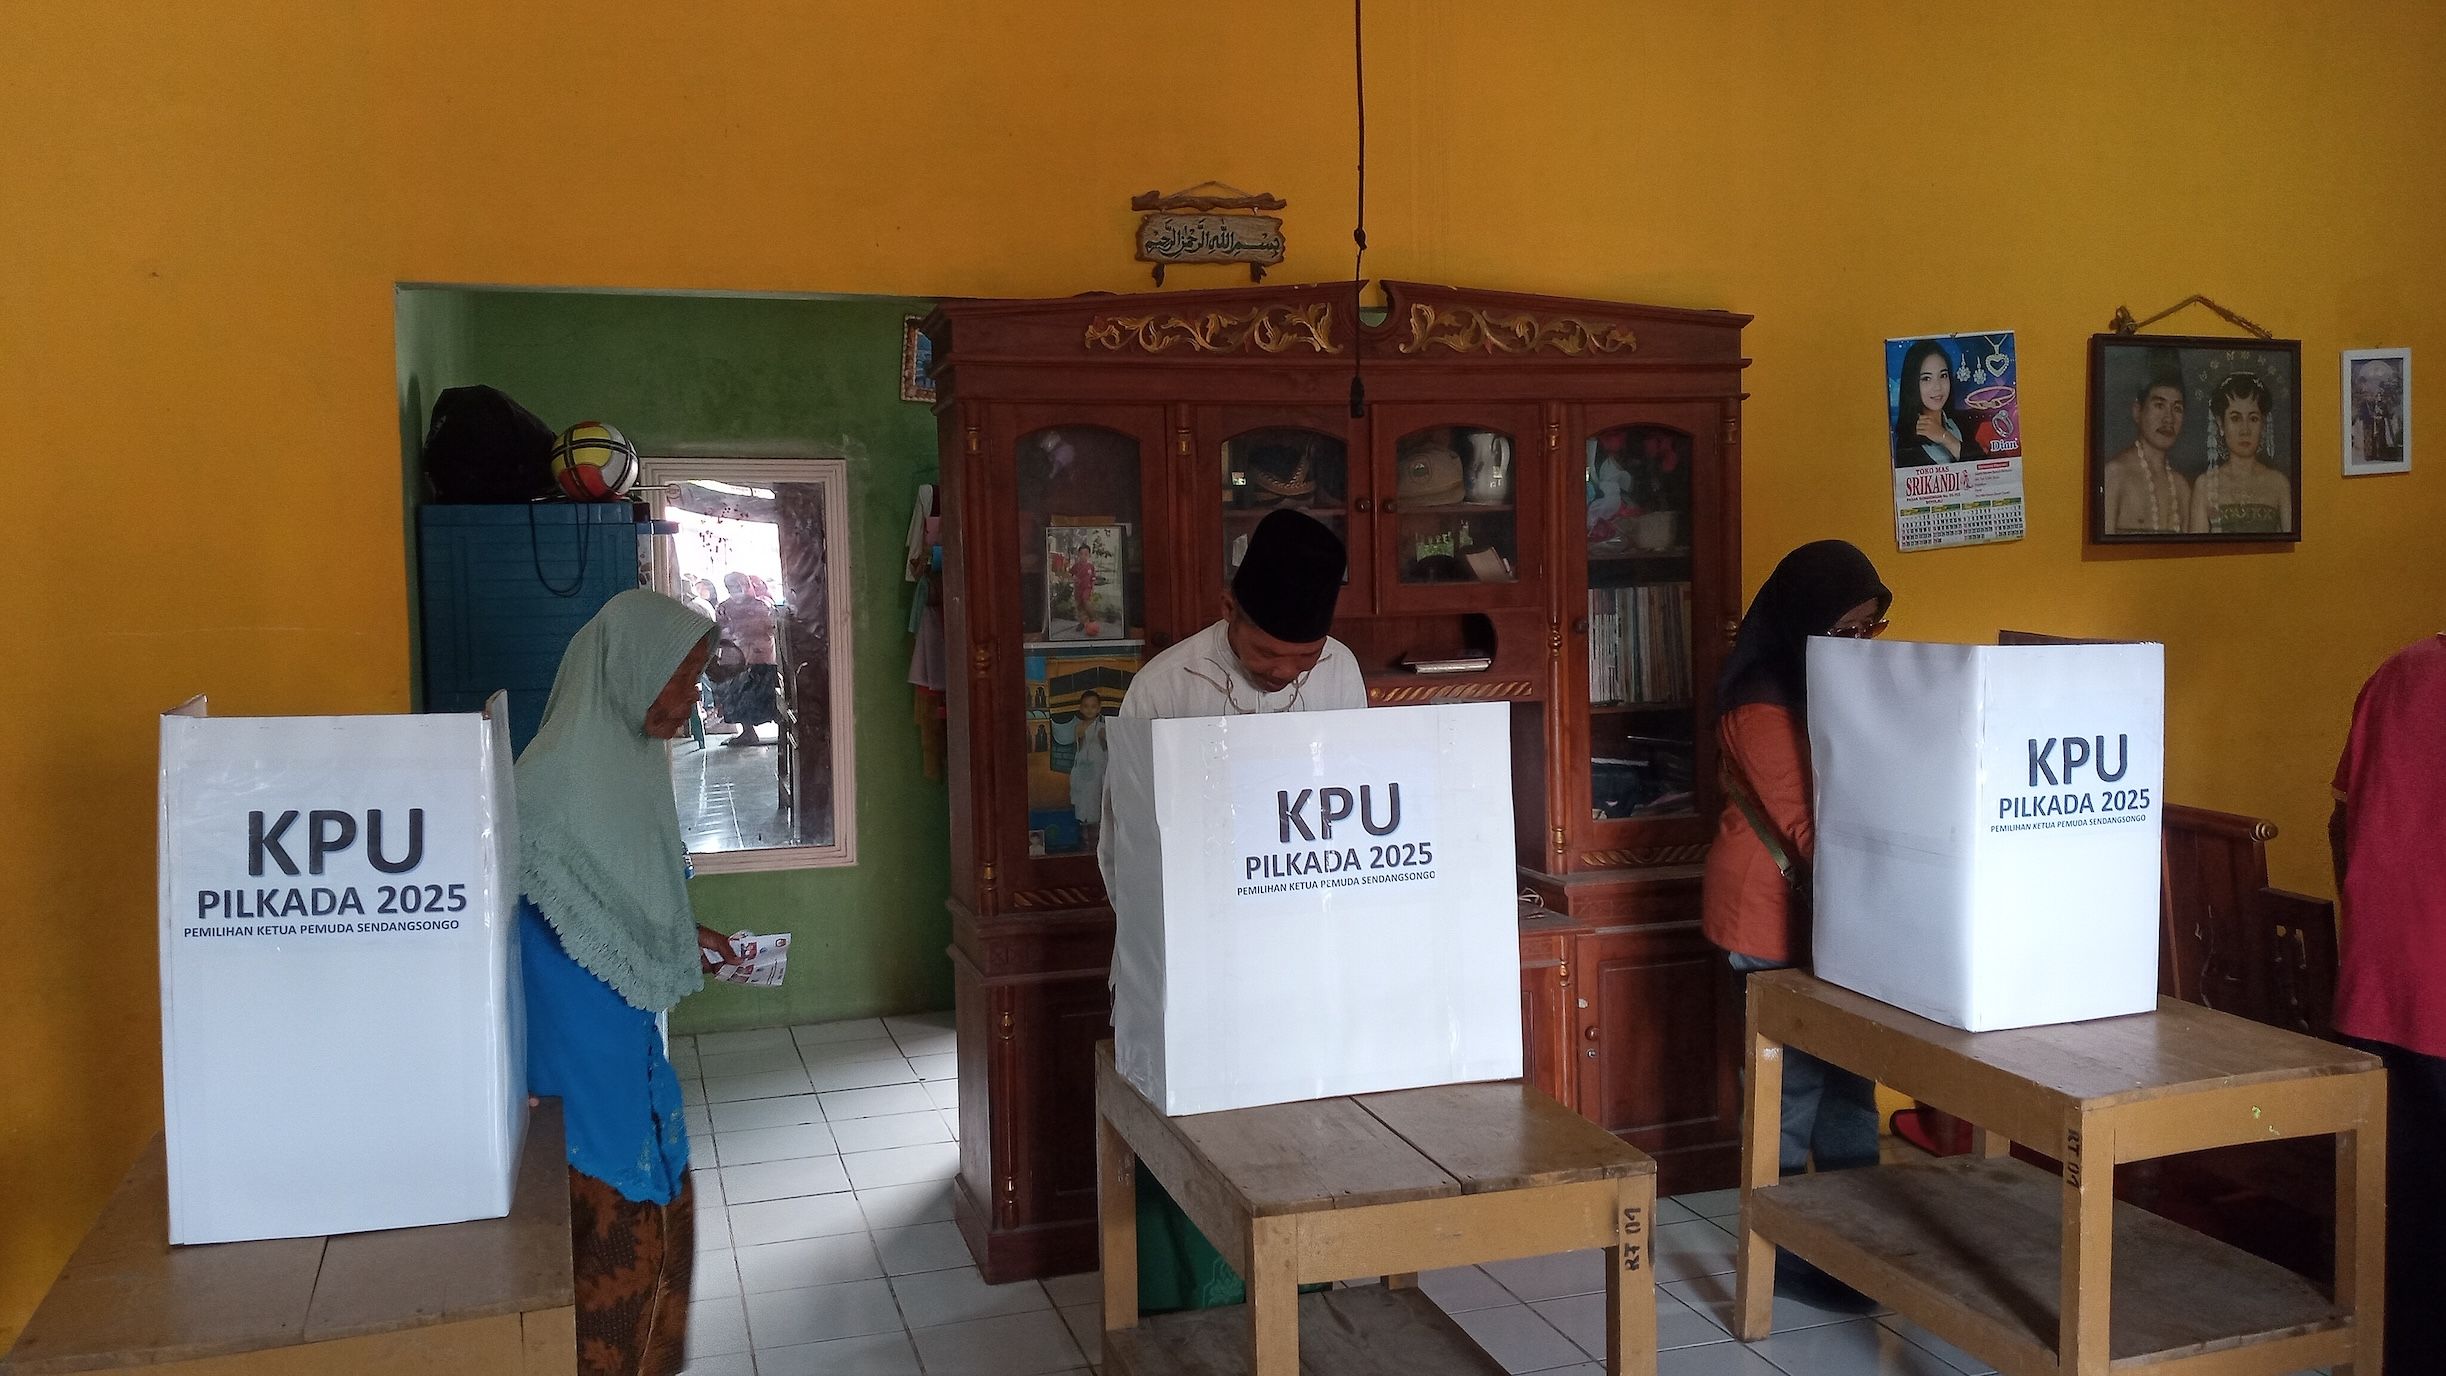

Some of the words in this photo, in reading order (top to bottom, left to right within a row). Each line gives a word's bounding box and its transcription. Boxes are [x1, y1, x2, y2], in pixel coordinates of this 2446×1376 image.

[1990, 439, 2019, 452] Dian
[1906, 472, 1960, 497] SRIKANDI
[2028, 733, 2128, 787] KPU
[1277, 782, 1401, 843] KPU
[1999, 793, 2094, 819] PILKADA
[2101, 788, 2150, 812] 2025
[1990, 823, 2031, 833] PEMILIHAN
[2032, 821, 2055, 830] KETUA
[2057, 819, 2088, 828] PEMUDA
[2089, 814, 2146, 826] SENDANGSONGO
[248, 808, 424, 877] KPU
[1246, 847, 1362, 880] PILKADA
[1369, 841, 1433, 869] 2025
[1237, 883, 1287, 896] PEMILIHAN
[1289, 880, 1318, 891] KETUA
[1320, 877, 1360, 888] PEMUDA
[1361, 870, 1436, 885] SENDANGSONGO
[198, 886, 365, 919] PILKADA
[376, 883, 468, 915] 2025
[184, 925, 253, 938] PEMILIHAN
[257, 924, 297, 936] KETUA
[300, 922, 354, 935] PEMUDA
[357, 919, 460, 933] SENDANGSONGO
[2067, 1128, 2080, 1157] RT
[1624, 1243, 1640, 1271] RT
